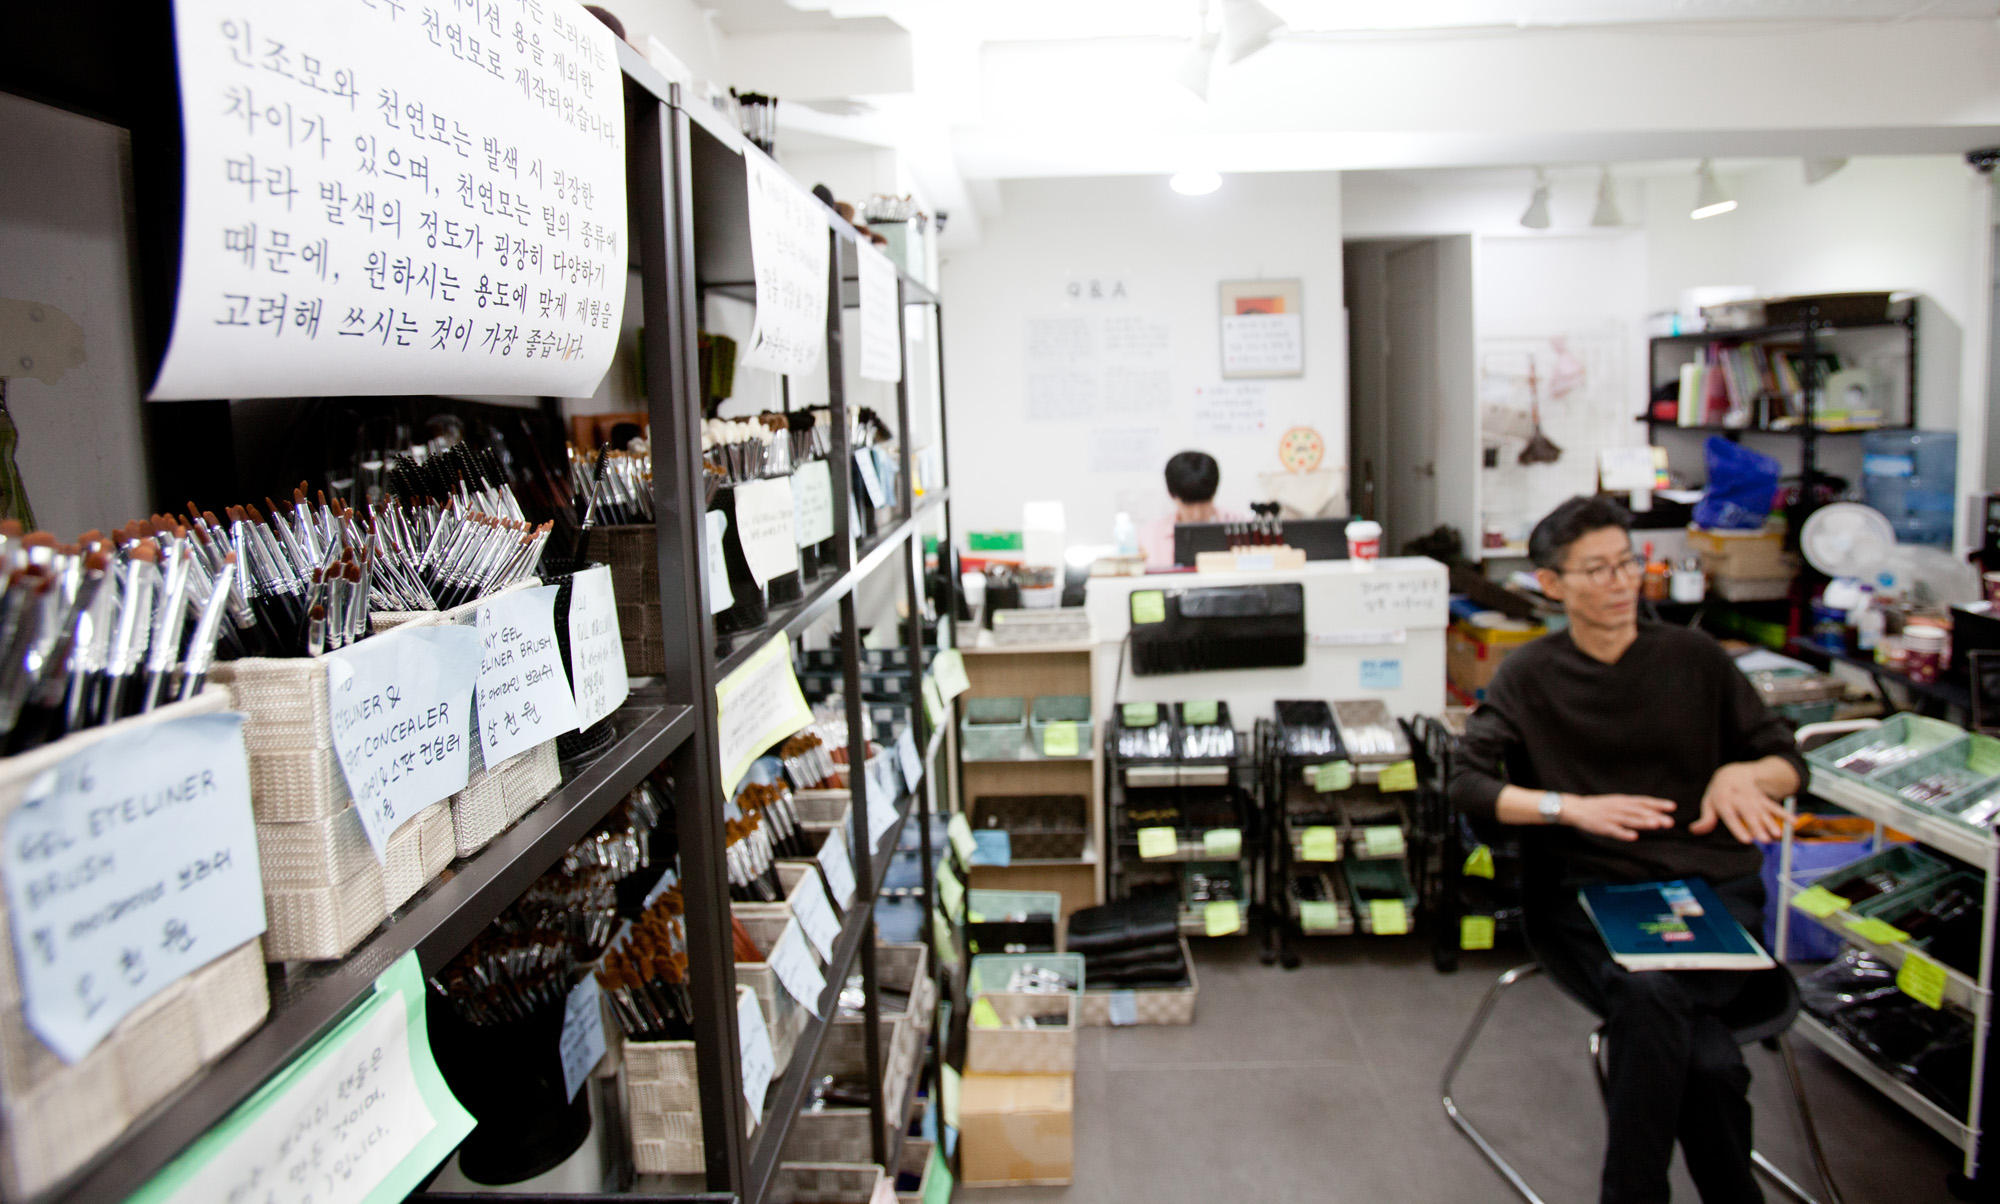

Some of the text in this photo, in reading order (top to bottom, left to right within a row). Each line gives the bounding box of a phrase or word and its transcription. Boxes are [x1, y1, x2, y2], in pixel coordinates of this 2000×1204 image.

[453, 0, 501, 38] 이션
[512, 21, 544, 67] 용을
[552, 52, 594, 100] 제외한
[552, 12, 605, 72] 브러쉬는
[421, 6, 620, 149] 천연모로 제작되었습니다.
[221, 19, 594, 211] 인조모와 천연모는 발색 시 굉장한
[223, 85, 617, 258] 차이가 있으며, 천연모는 털의 종류에
[225, 153, 605, 291] 따라 발색의 정도가 굉장히 다양하기
[224, 222, 613, 329] 때문에, 원하시는 용도에 맞게 제형을
[214, 292, 585, 361] 고려해 쓰시는 것이 가장 좋습니다.
[501, 626, 523, 645] GEL
[519, 635, 552, 658] BRUSH
[385, 684, 402, 710] &
[488, 674, 520, 701] 아이라인
[525, 663, 554, 687] 브러쉬
[363, 702, 450, 758] CONCEALER
[391, 752, 416, 783] 스팟
[419, 733, 461, 766] 컨실러
[88, 768, 217, 839] EYELINER
